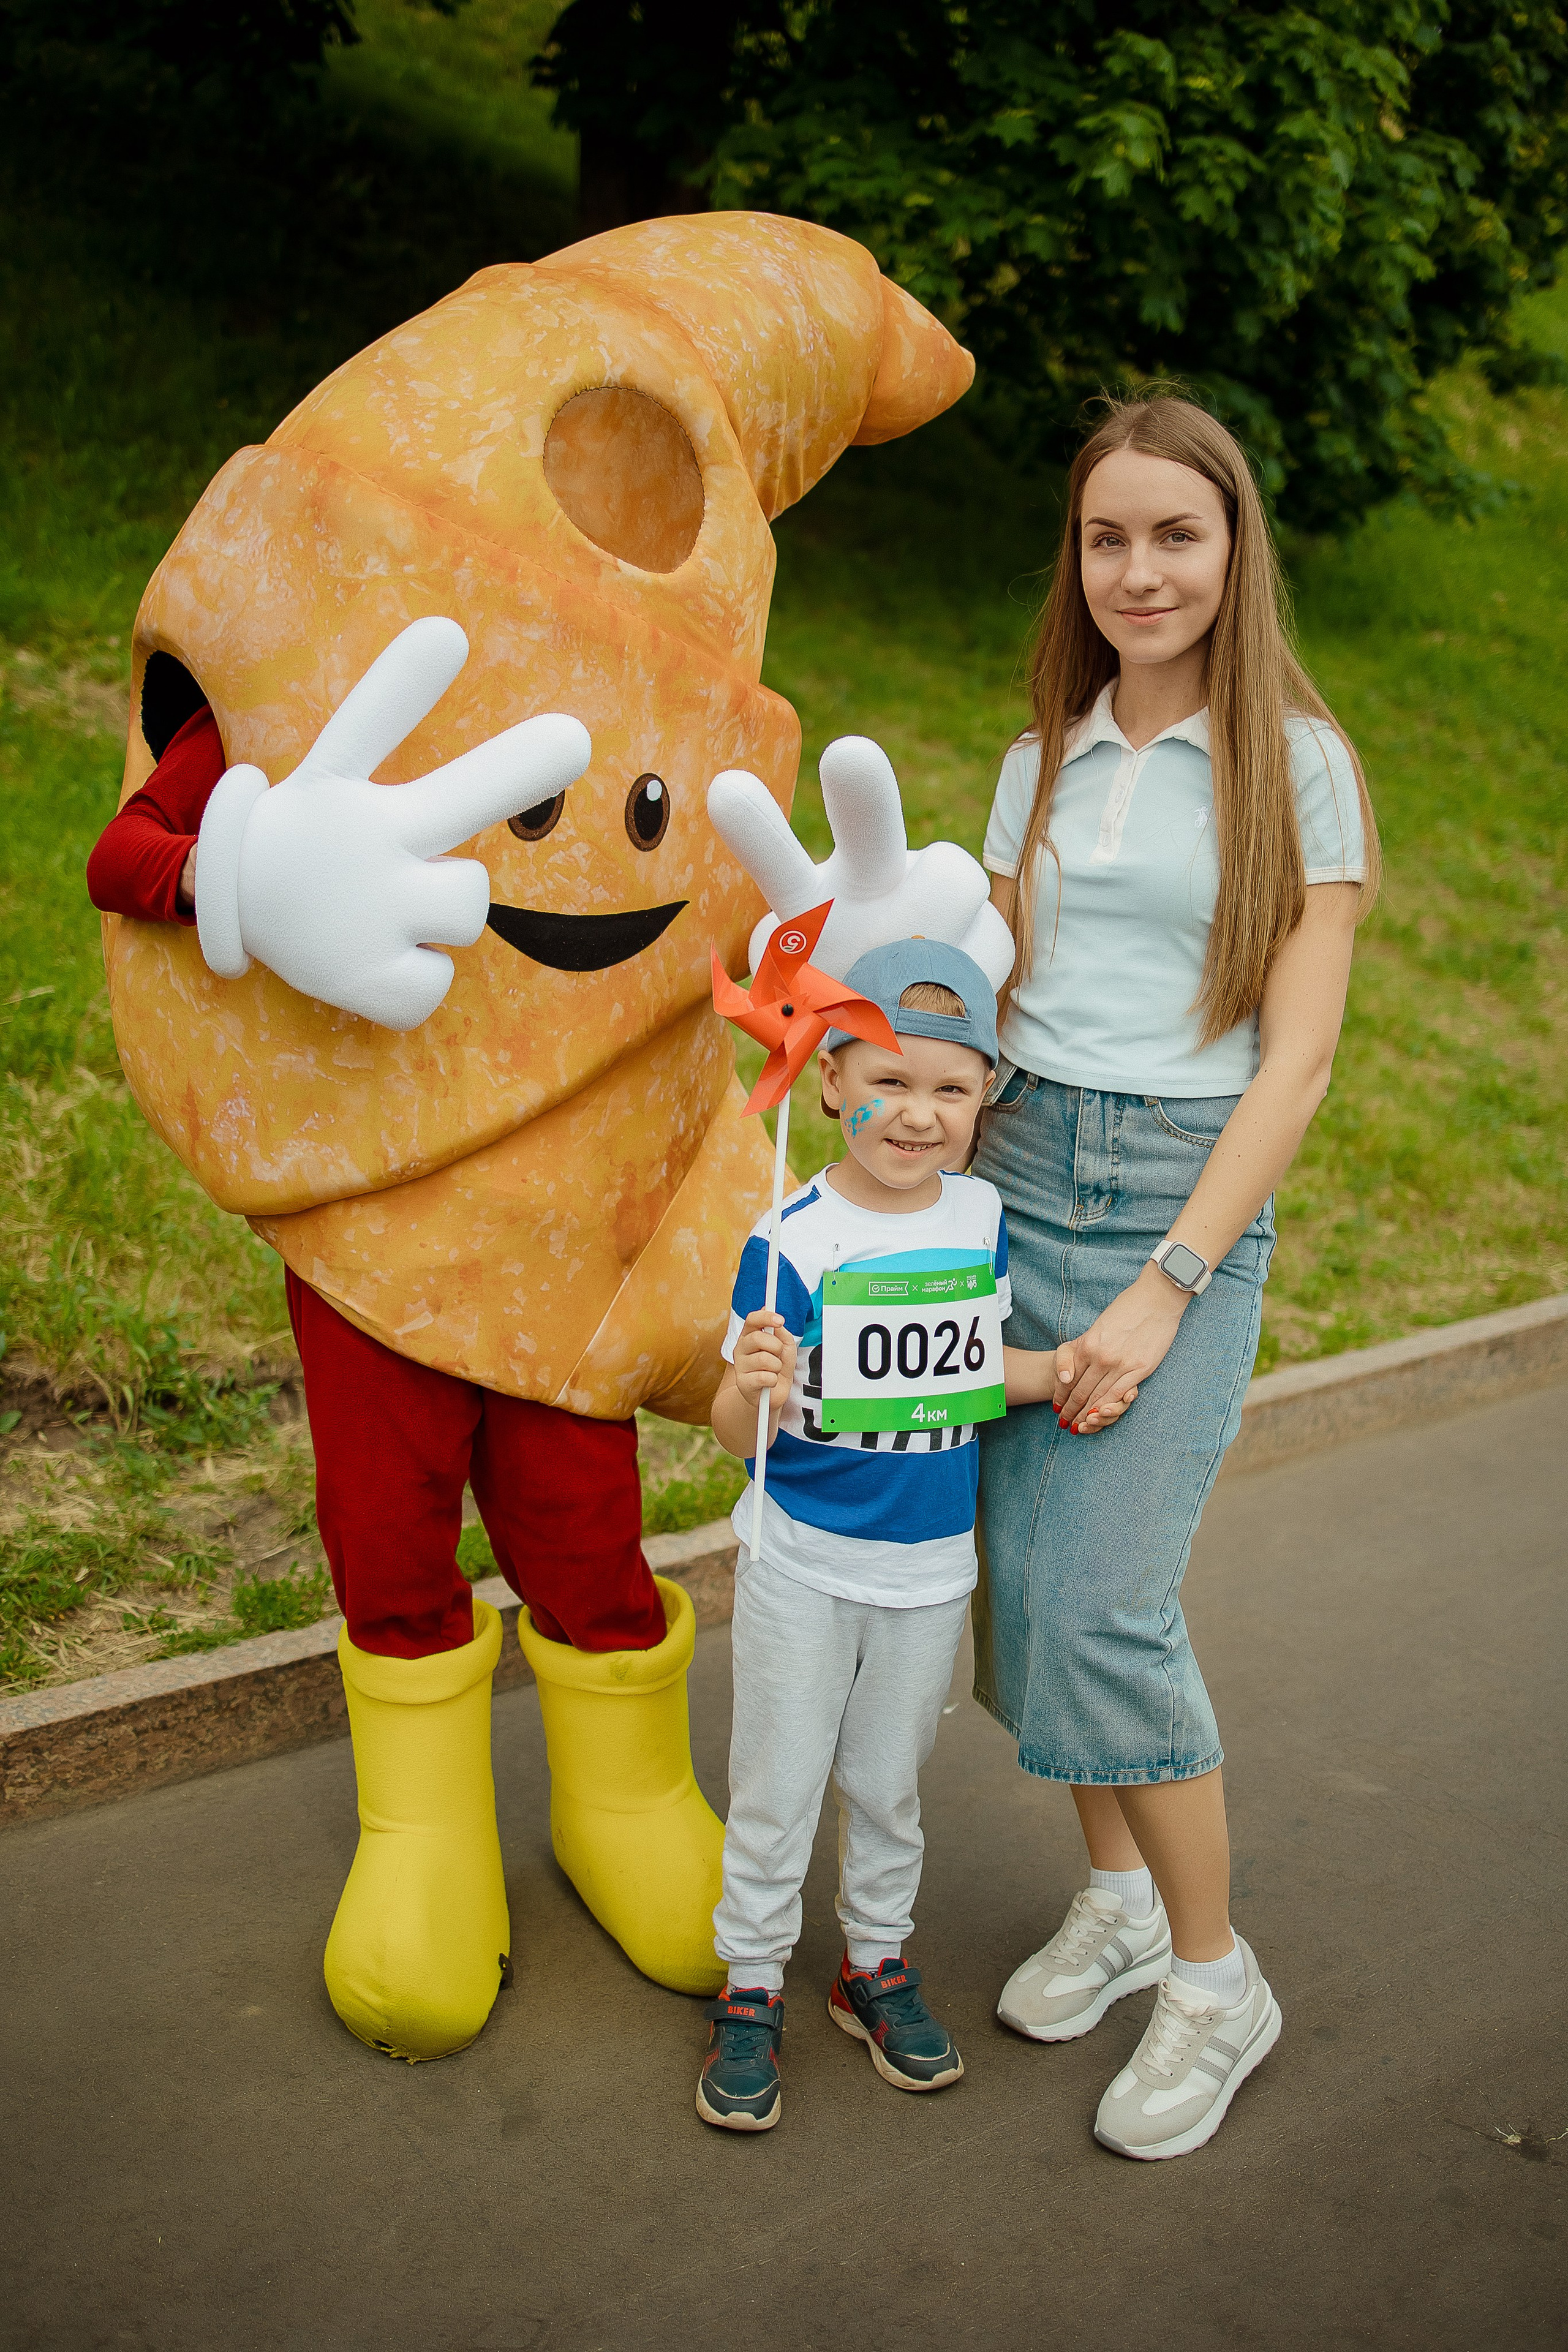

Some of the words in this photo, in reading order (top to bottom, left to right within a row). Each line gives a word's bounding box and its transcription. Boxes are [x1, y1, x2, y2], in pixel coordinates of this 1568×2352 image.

[782, 934, 801, 952] 5
[881, 1284, 903, 1293] Прайм
[858, 1315, 986, 1380] 0026
[880, 1975, 907, 1989] BIKER
[727, 2005, 756, 2016] BIKER
